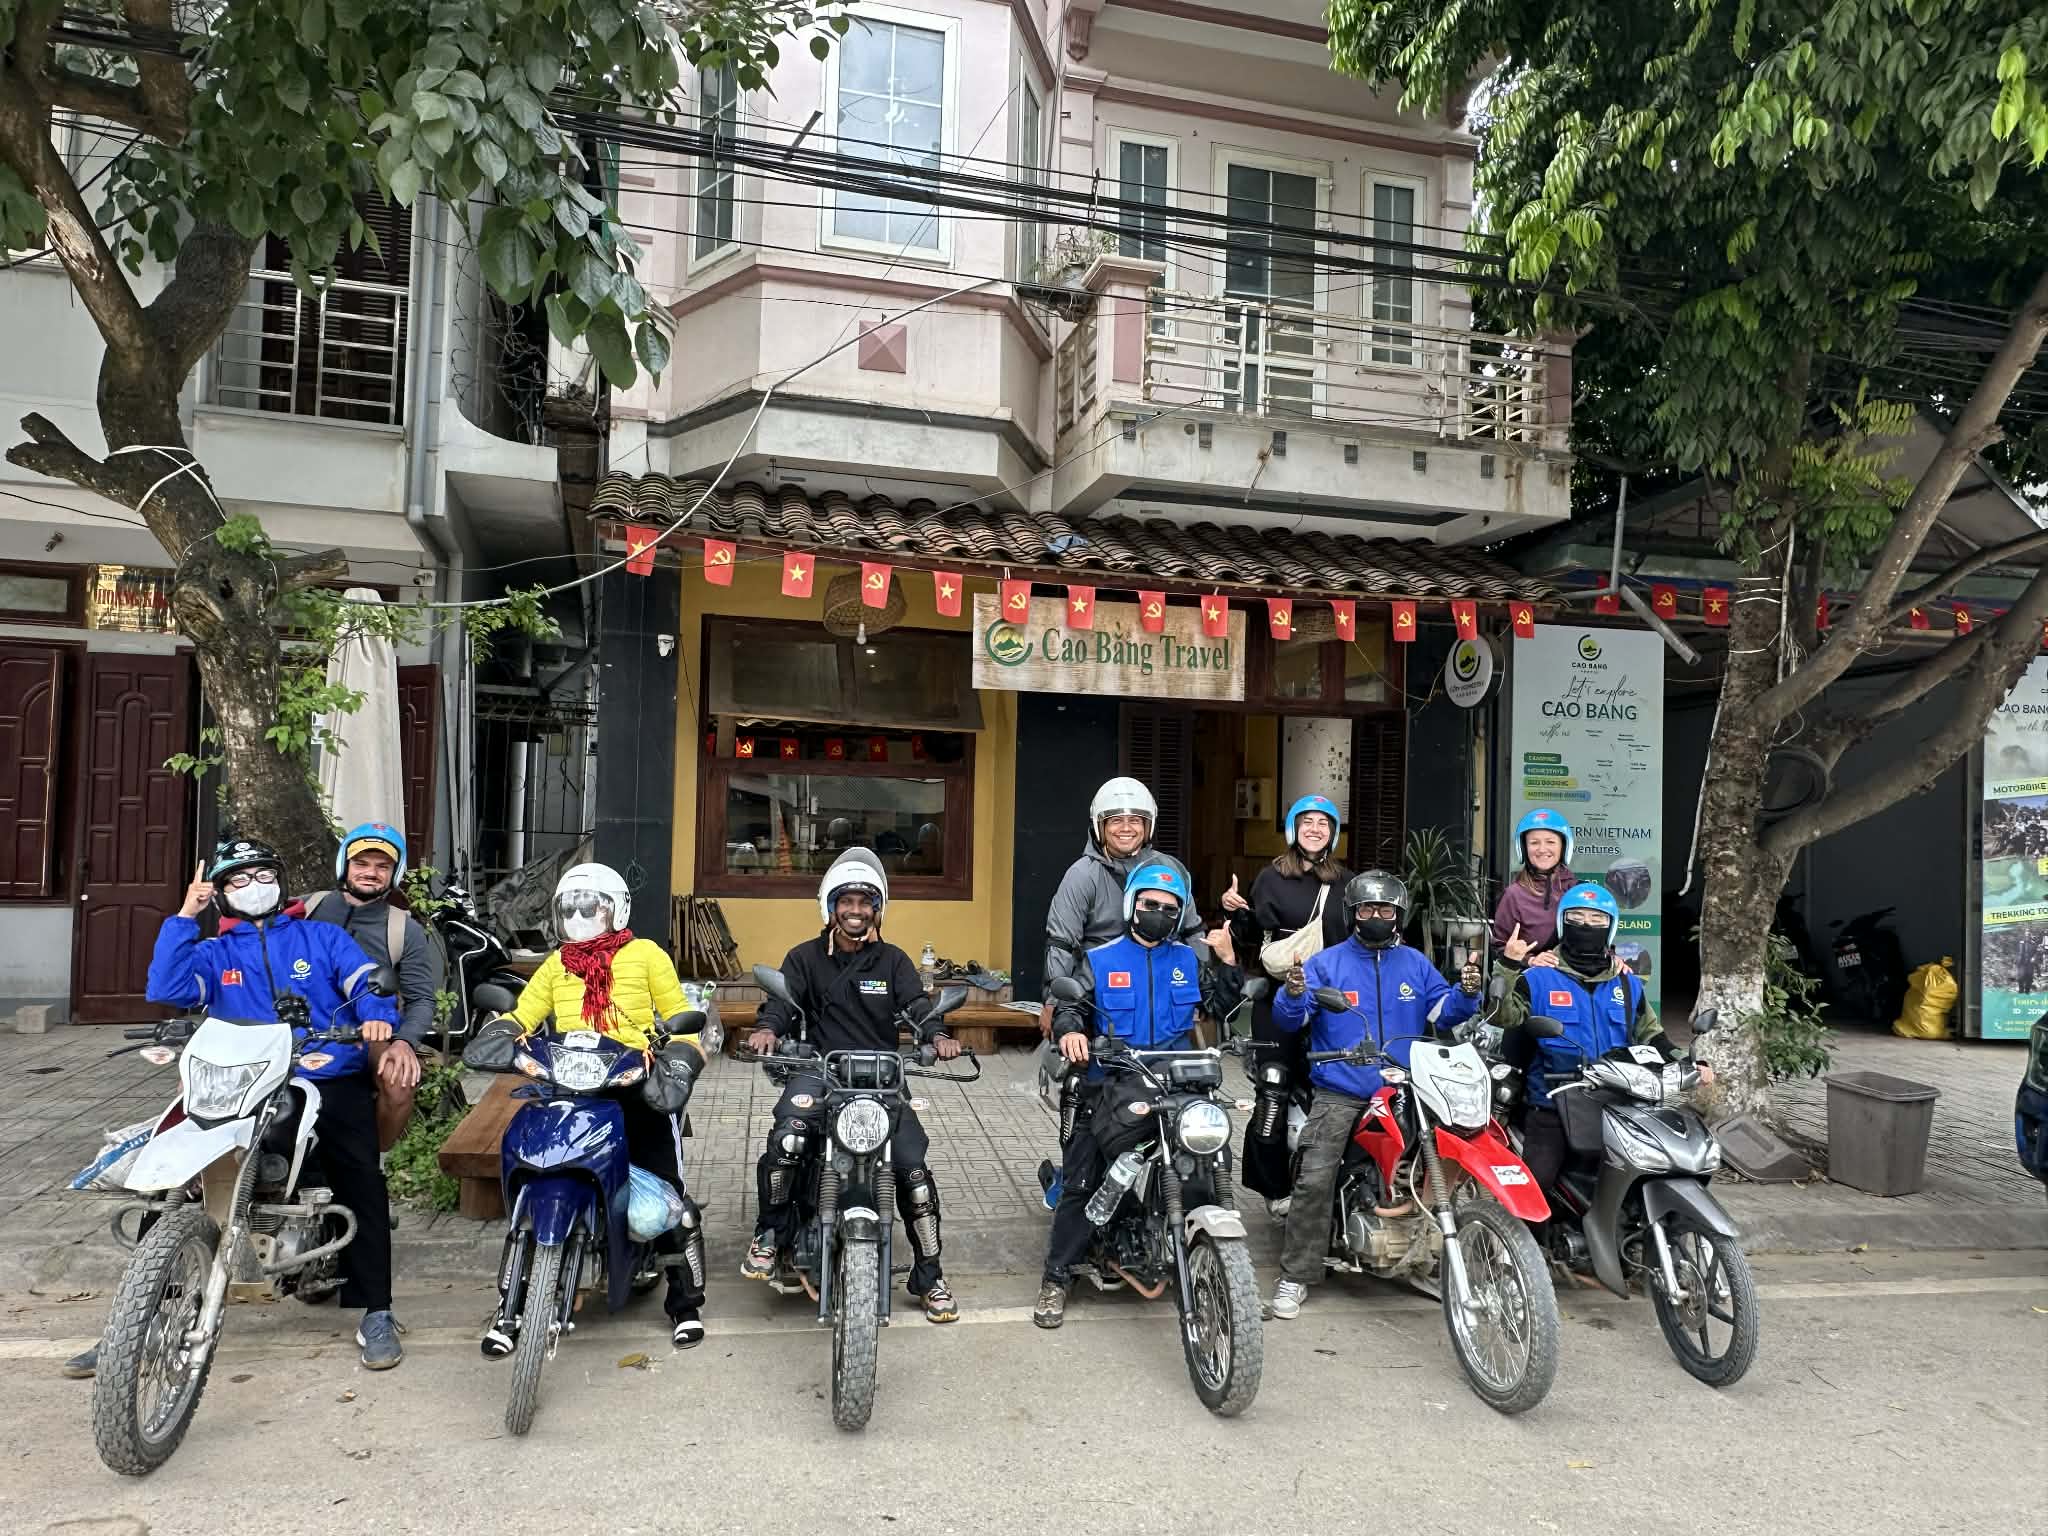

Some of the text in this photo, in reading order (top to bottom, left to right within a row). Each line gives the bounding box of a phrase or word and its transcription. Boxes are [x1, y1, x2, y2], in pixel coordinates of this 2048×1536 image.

[1042, 628, 1088, 664] Cao
[1160, 635, 1229, 670] Travel
[1594, 674, 1638, 704] explore
[1541, 701, 1638, 720] CAO BANG
[1993, 782, 2047, 794] MOTORBIKE
[1595, 827, 1652, 839] VIETNAM
[1991, 909, 2036, 919] TREKKING
